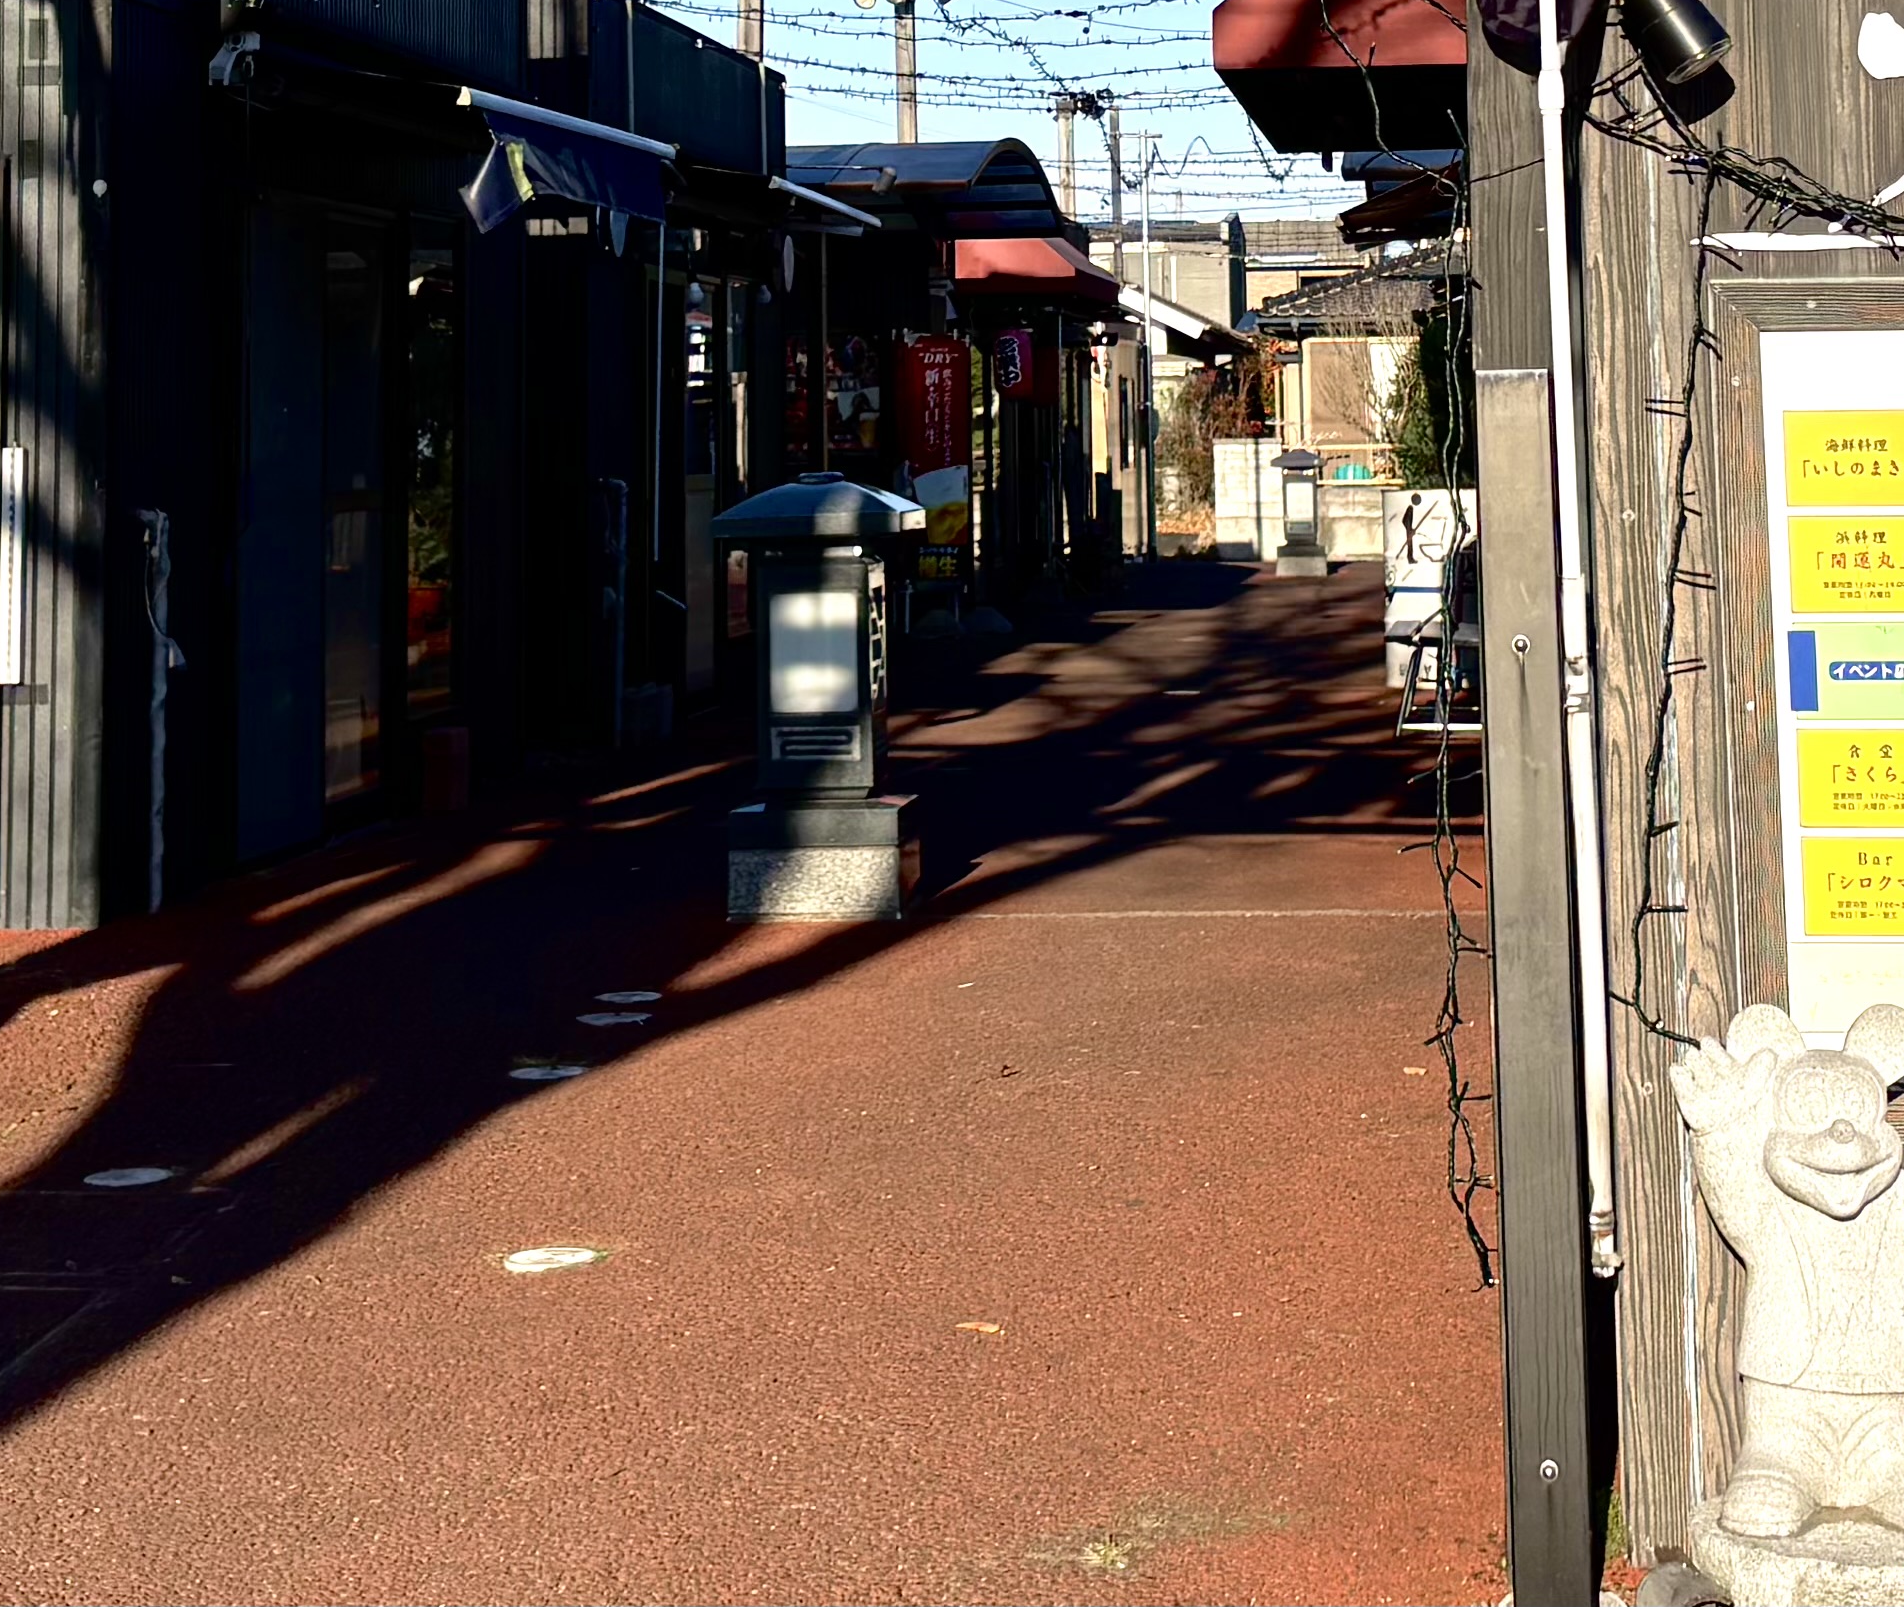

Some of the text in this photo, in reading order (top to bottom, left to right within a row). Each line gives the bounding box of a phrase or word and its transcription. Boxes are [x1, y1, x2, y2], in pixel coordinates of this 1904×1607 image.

[1825, 438, 1888, 452] 海鮮料理
[1858, 852, 1893, 866] Bar
